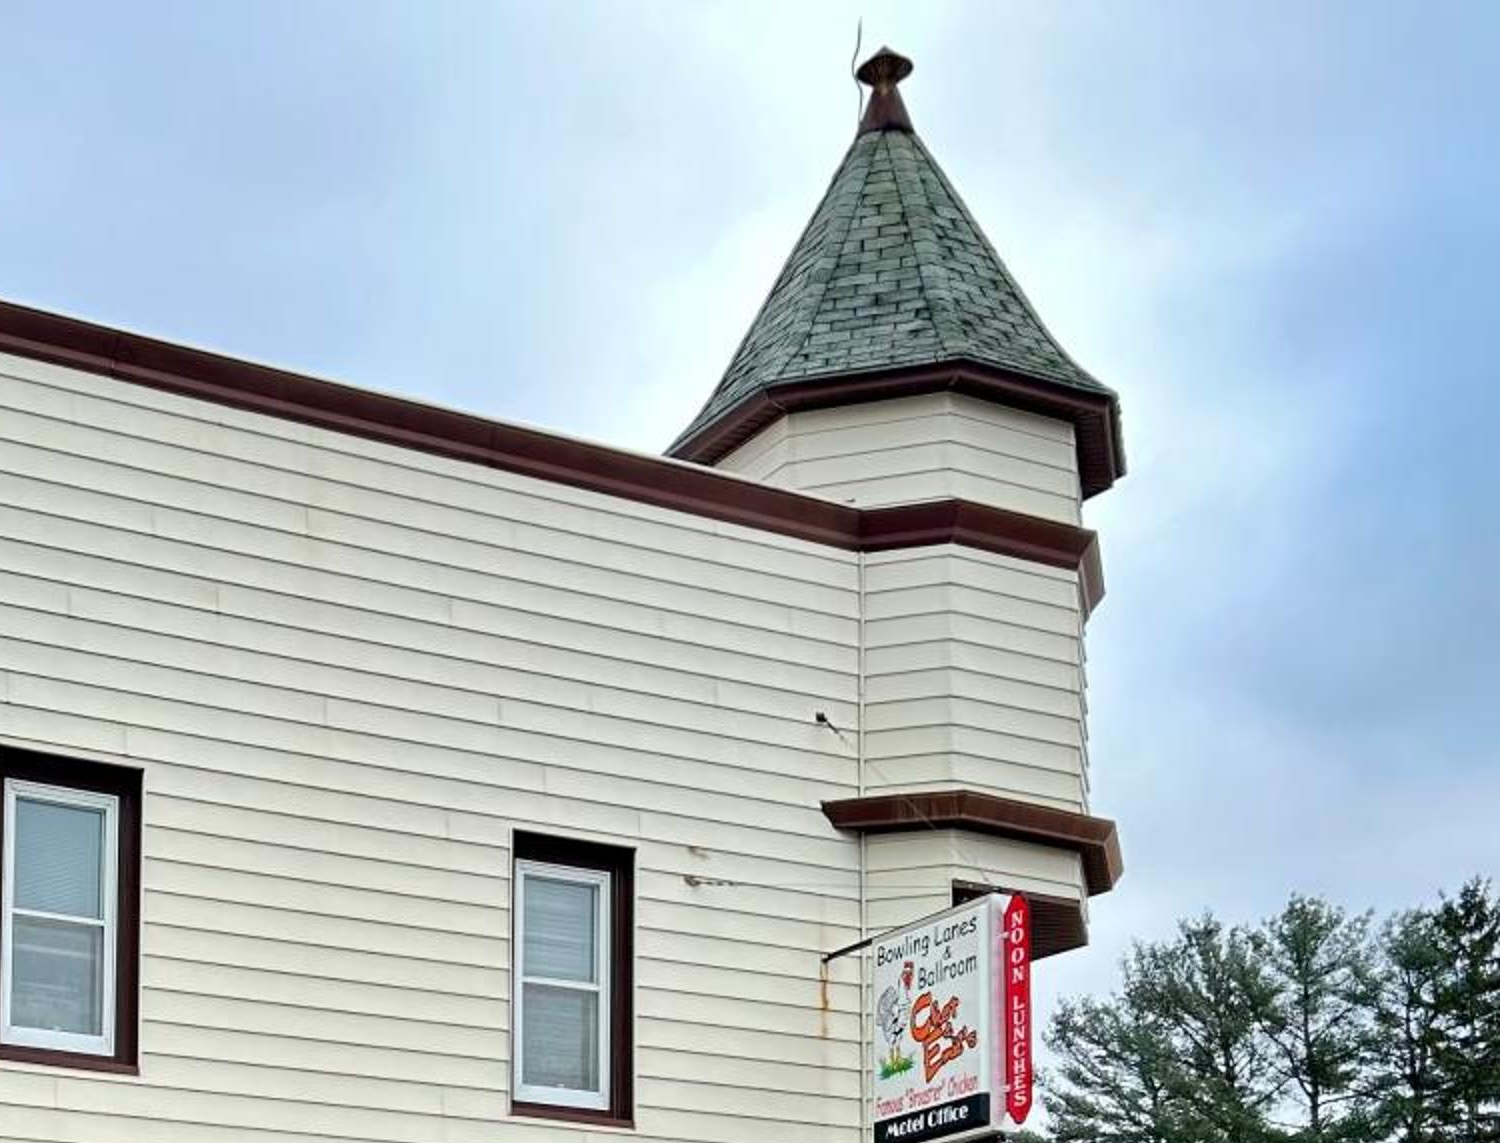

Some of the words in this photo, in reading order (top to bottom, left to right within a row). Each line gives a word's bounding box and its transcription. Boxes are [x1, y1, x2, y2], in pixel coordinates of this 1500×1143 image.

[876, 935, 930, 967] Bowling
[933, 916, 978, 947] Lanes
[942, 945, 952, 961] &
[1011, 909, 1025, 984] NOON
[918, 954, 978, 990] Ballroom
[1012, 995, 1028, 1107] LUNCHES
[885, 1113, 925, 1139] Motel
[927, 1104, 970, 1128] Office
